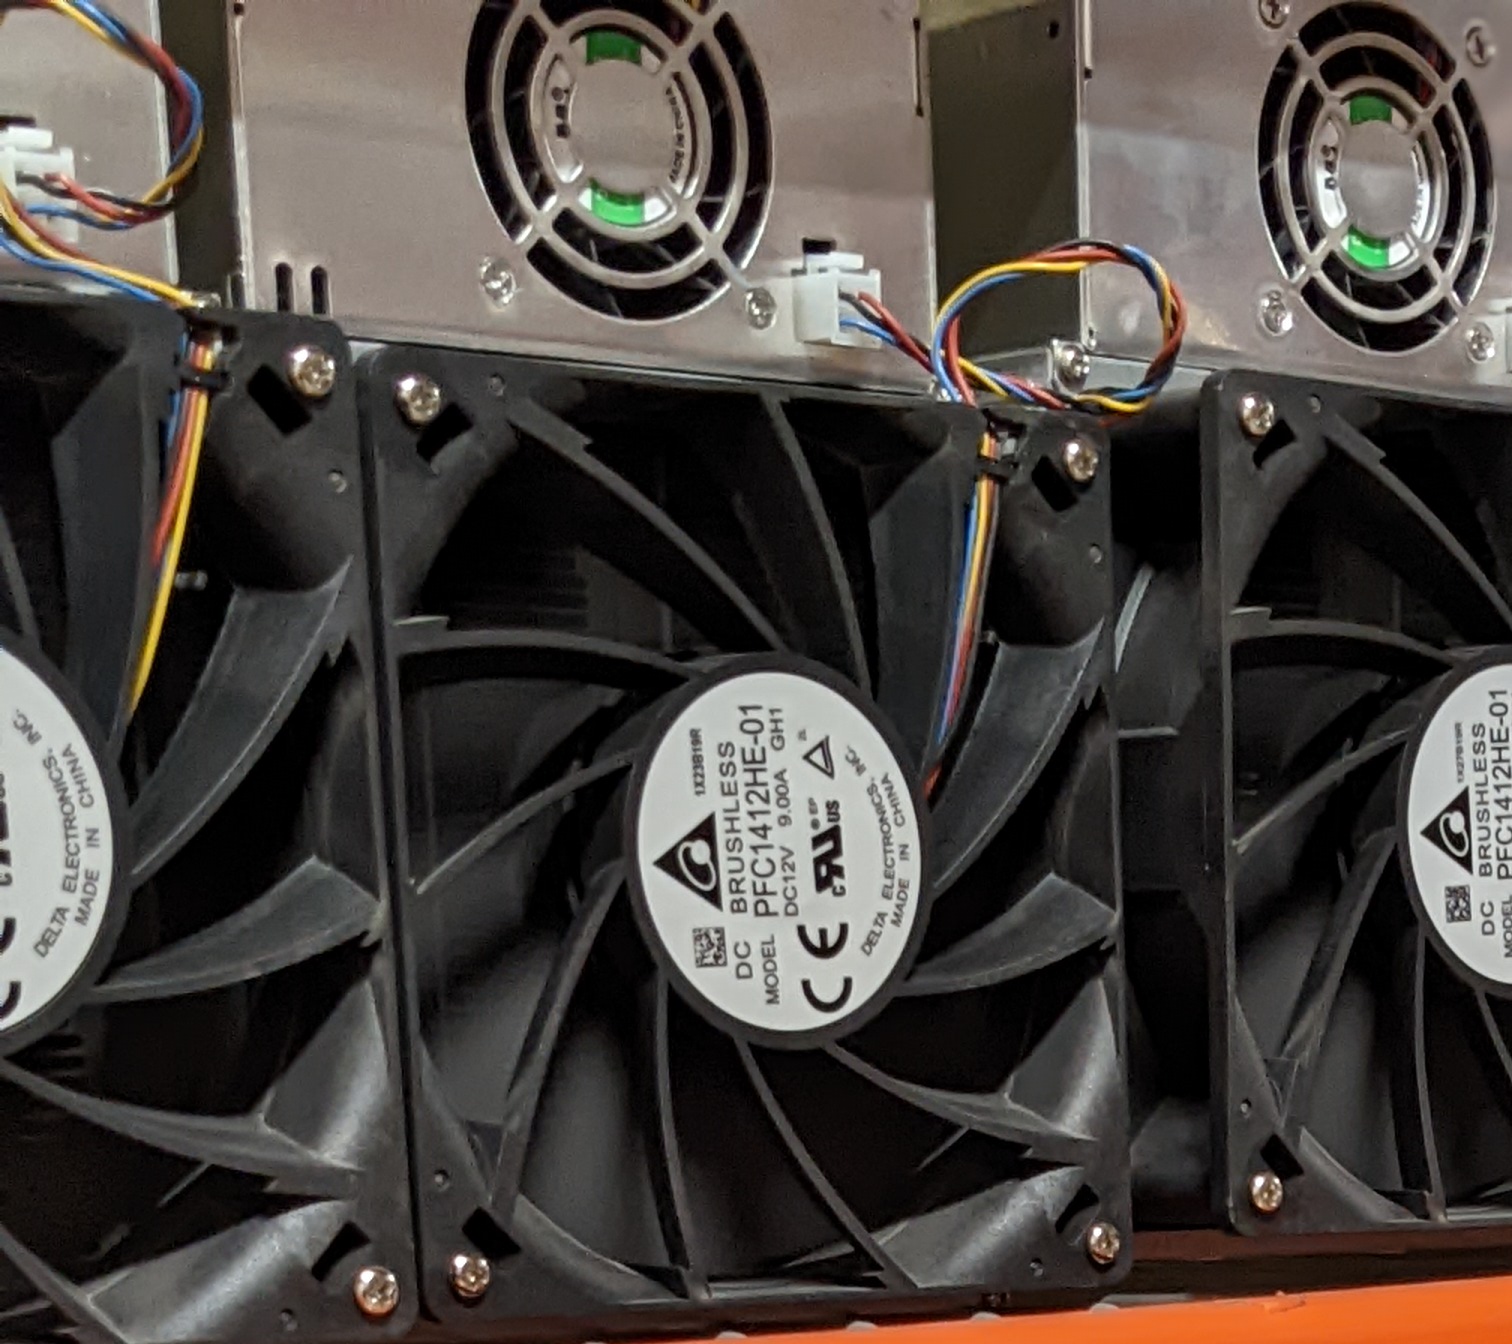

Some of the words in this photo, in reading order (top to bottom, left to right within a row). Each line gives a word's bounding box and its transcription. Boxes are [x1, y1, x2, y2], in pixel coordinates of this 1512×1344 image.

[11, 707, 43, 746] INC.
[769, 706, 786, 751] GH1
[61, 743, 95, 809] CHINA
[689, 728, 707, 797] 1X23B19R
[843, 744, 868, 776] INC.
[42, 748, 81, 895] ELECTRONICS,
[738, 704, 779, 917] PFC1412HE-01
[775, 769, 792, 827] 9.00A
[882, 772, 907, 827] CHINA
[1472, 722, 1493, 877] BRUSHLESS
[86, 827, 100, 848] IN
[718, 741, 748, 914] BRUSHLESS
[898, 843, 910, 861] IN
[75, 869, 100, 927] MADE
[779, 845, 799, 917] DC12V
[889, 878, 910, 928] MADE
[33, 906, 72, 959] DELTA
[859, 912, 889, 956] DELTA
[1481, 901, 1495, 937] DC
[733, 941, 753, 979] DC
[761, 934, 780, 1005] MODEL
